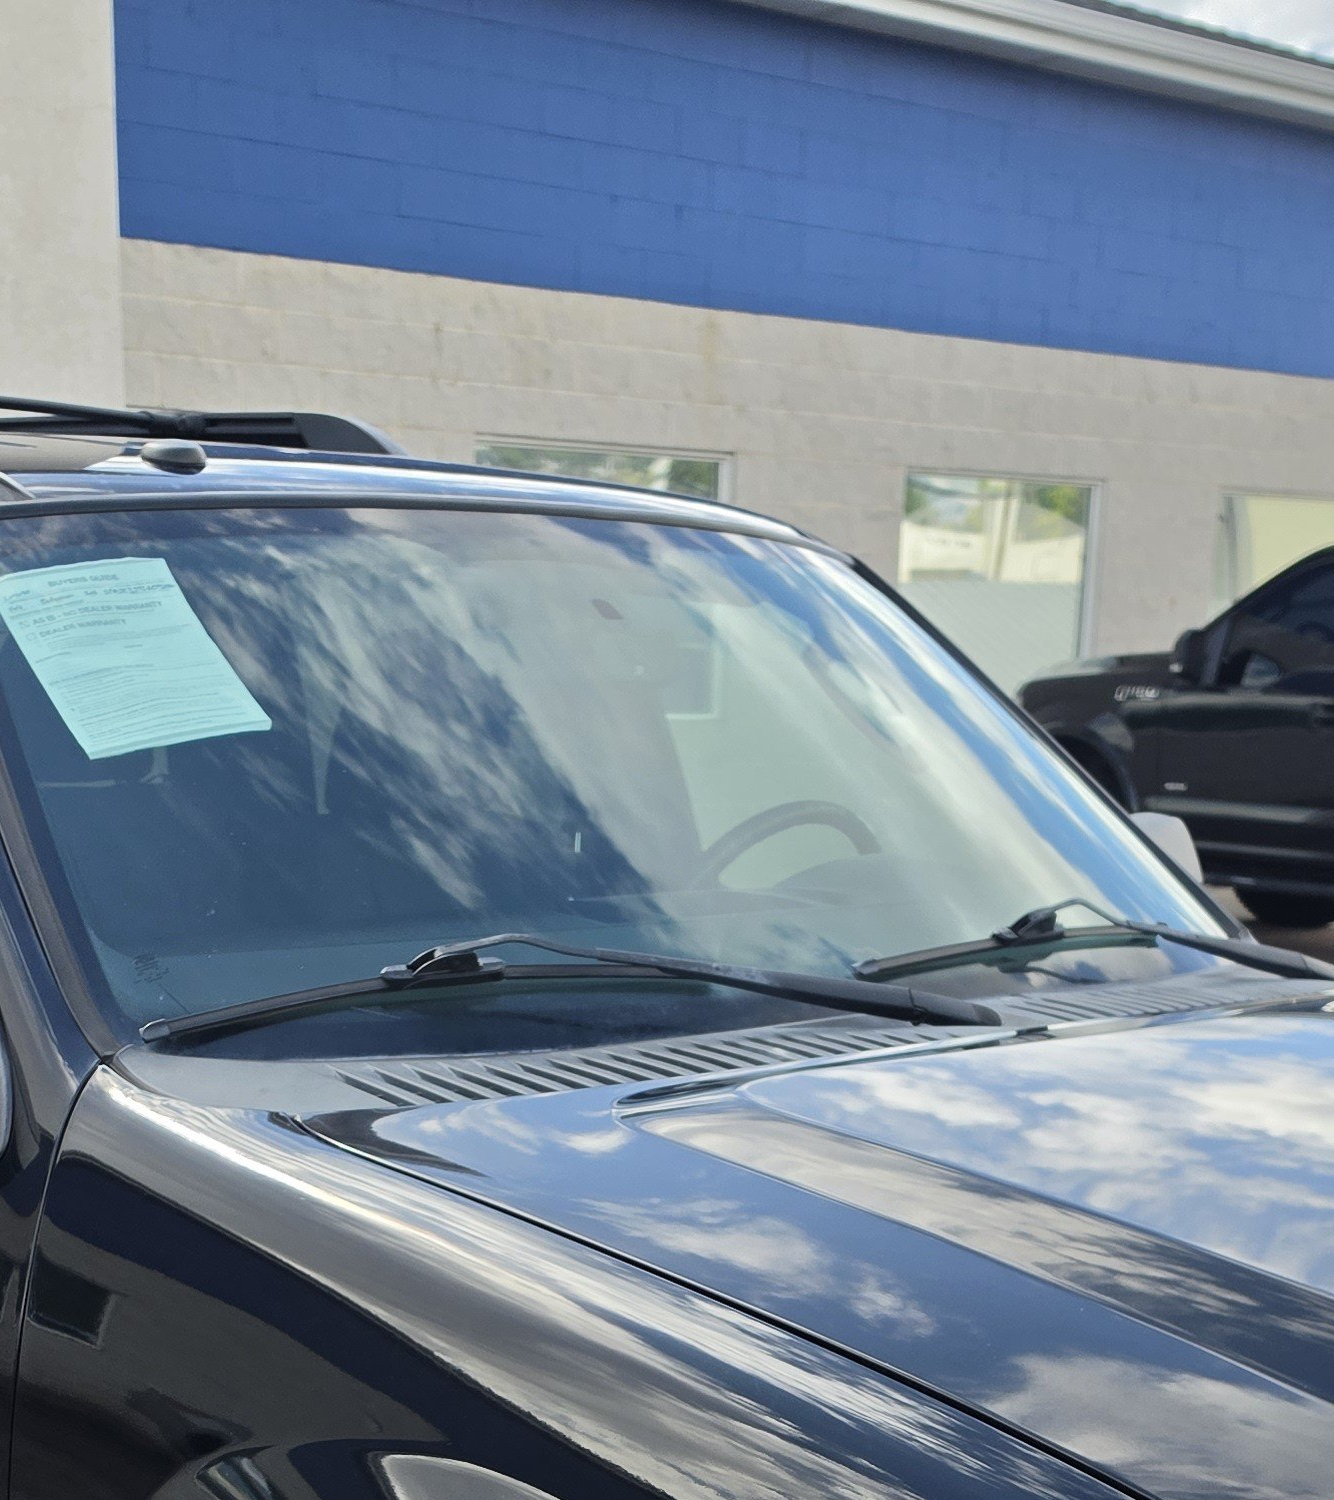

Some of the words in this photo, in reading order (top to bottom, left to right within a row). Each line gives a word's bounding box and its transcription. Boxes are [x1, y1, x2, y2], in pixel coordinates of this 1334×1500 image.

[89, 573, 120, 583] GUIDE
[78, 604, 115, 615] DEALER
[115, 600, 163, 612] WARRANTY
[39, 623, 78, 638] DEALER
[77, 618, 127, 629] WARRANTY
